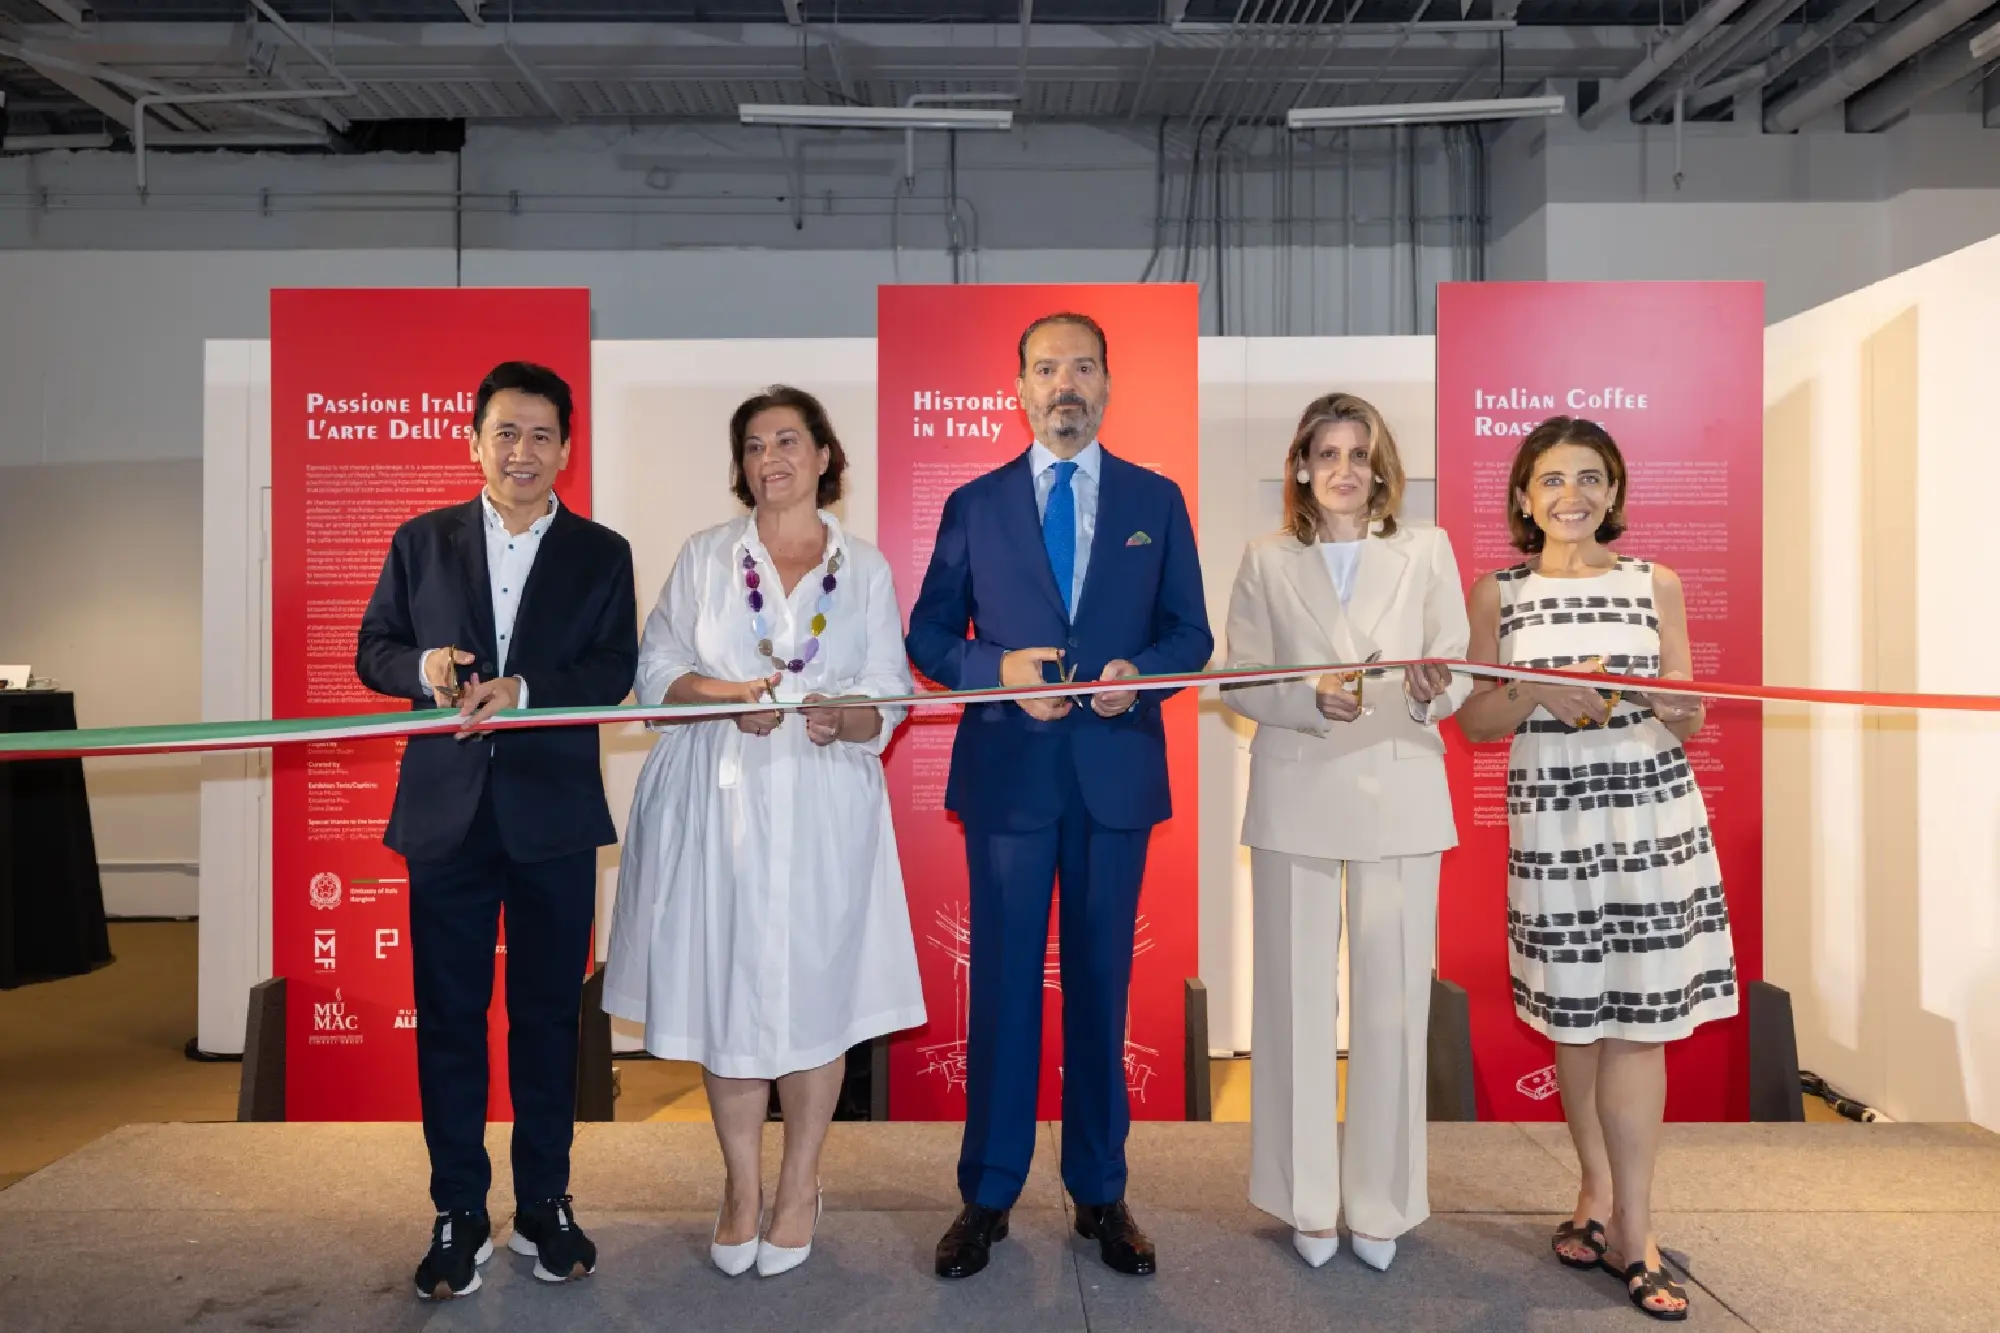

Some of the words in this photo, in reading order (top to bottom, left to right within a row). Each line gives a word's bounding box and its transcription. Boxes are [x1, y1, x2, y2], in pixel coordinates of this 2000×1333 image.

[422, 392, 474, 413] Itali
[914, 389, 1020, 411] Historic
[1475, 387, 1554, 410] Italian
[1566, 387, 1648, 410] Coffee
[390, 418, 474, 440] Dell'es
[947, 416, 1004, 443] Italy
